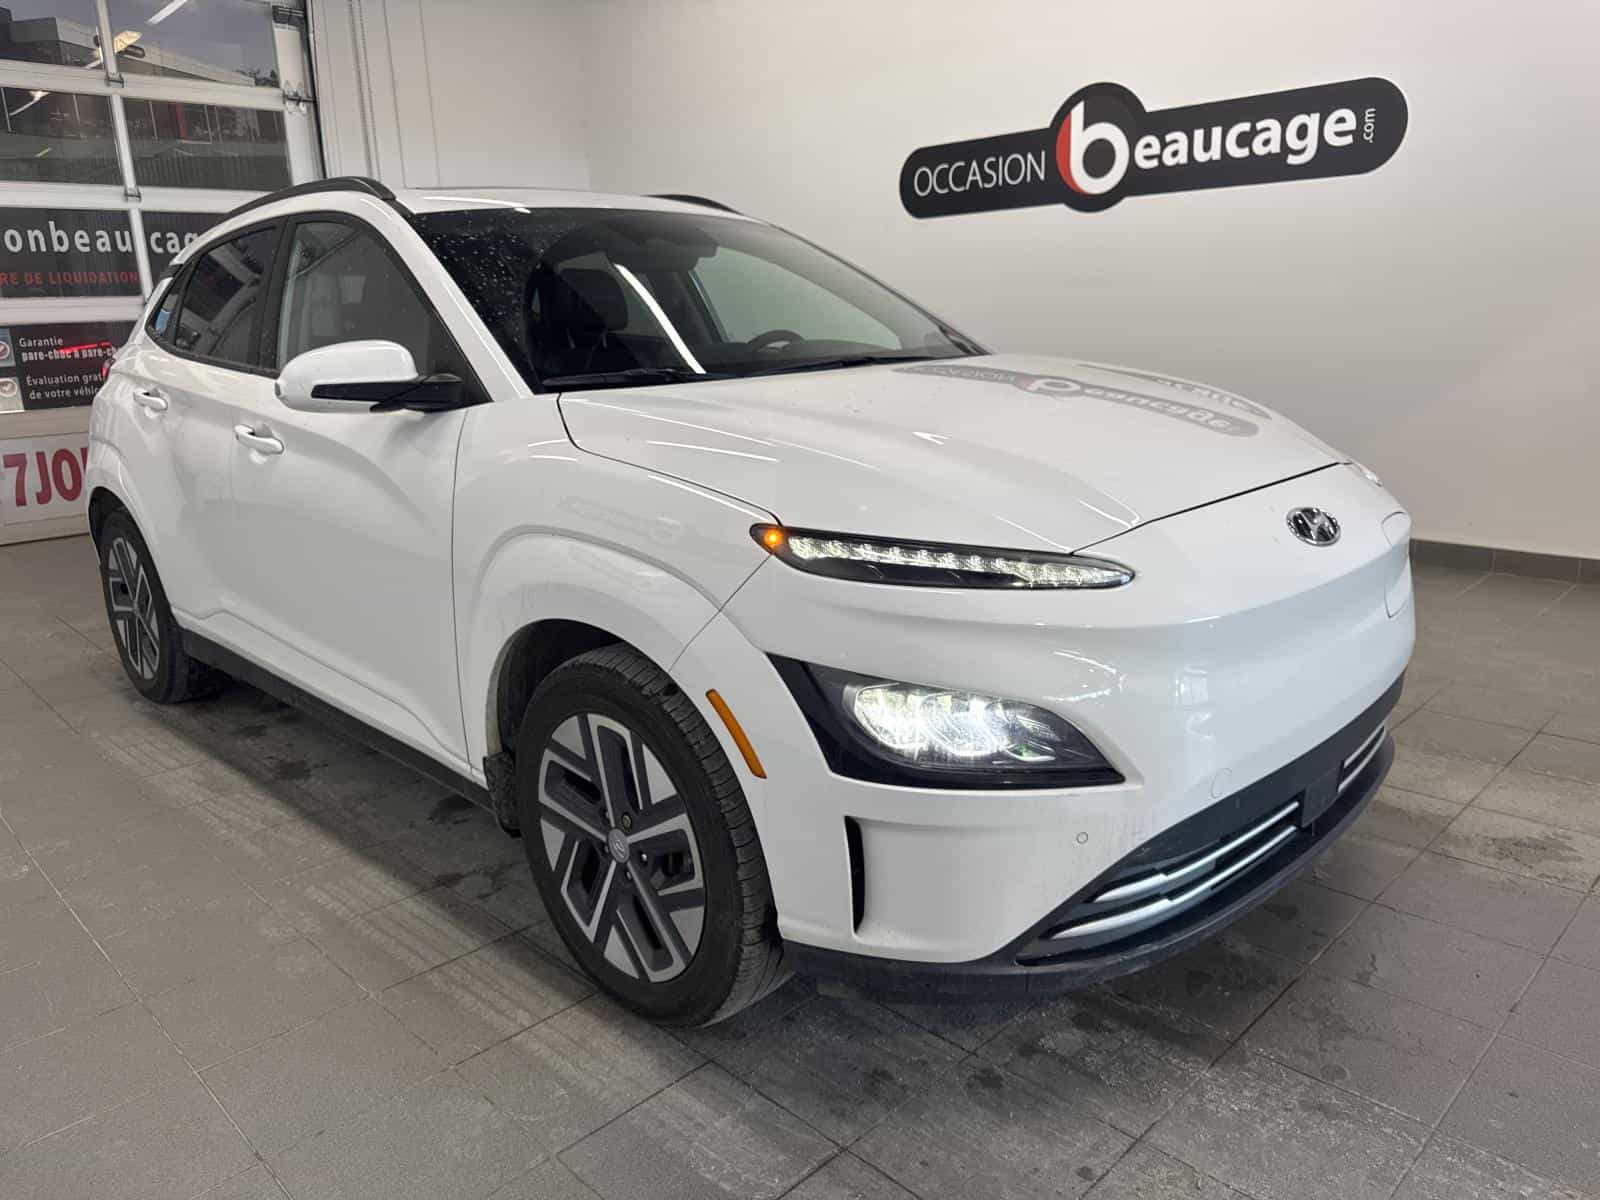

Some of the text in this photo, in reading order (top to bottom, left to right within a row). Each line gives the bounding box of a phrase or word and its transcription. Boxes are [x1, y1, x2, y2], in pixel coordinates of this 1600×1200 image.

[913, 149, 1046, 198] OCCASION
[24, 271, 43, 286] DE
[48, 271, 138, 286] LIQUIDATION
[19, 337, 64, 348] Garantie
[26, 373, 80, 387] Évaluation
[29, 389, 42, 400] de
[45, 388, 72, 398] votre
